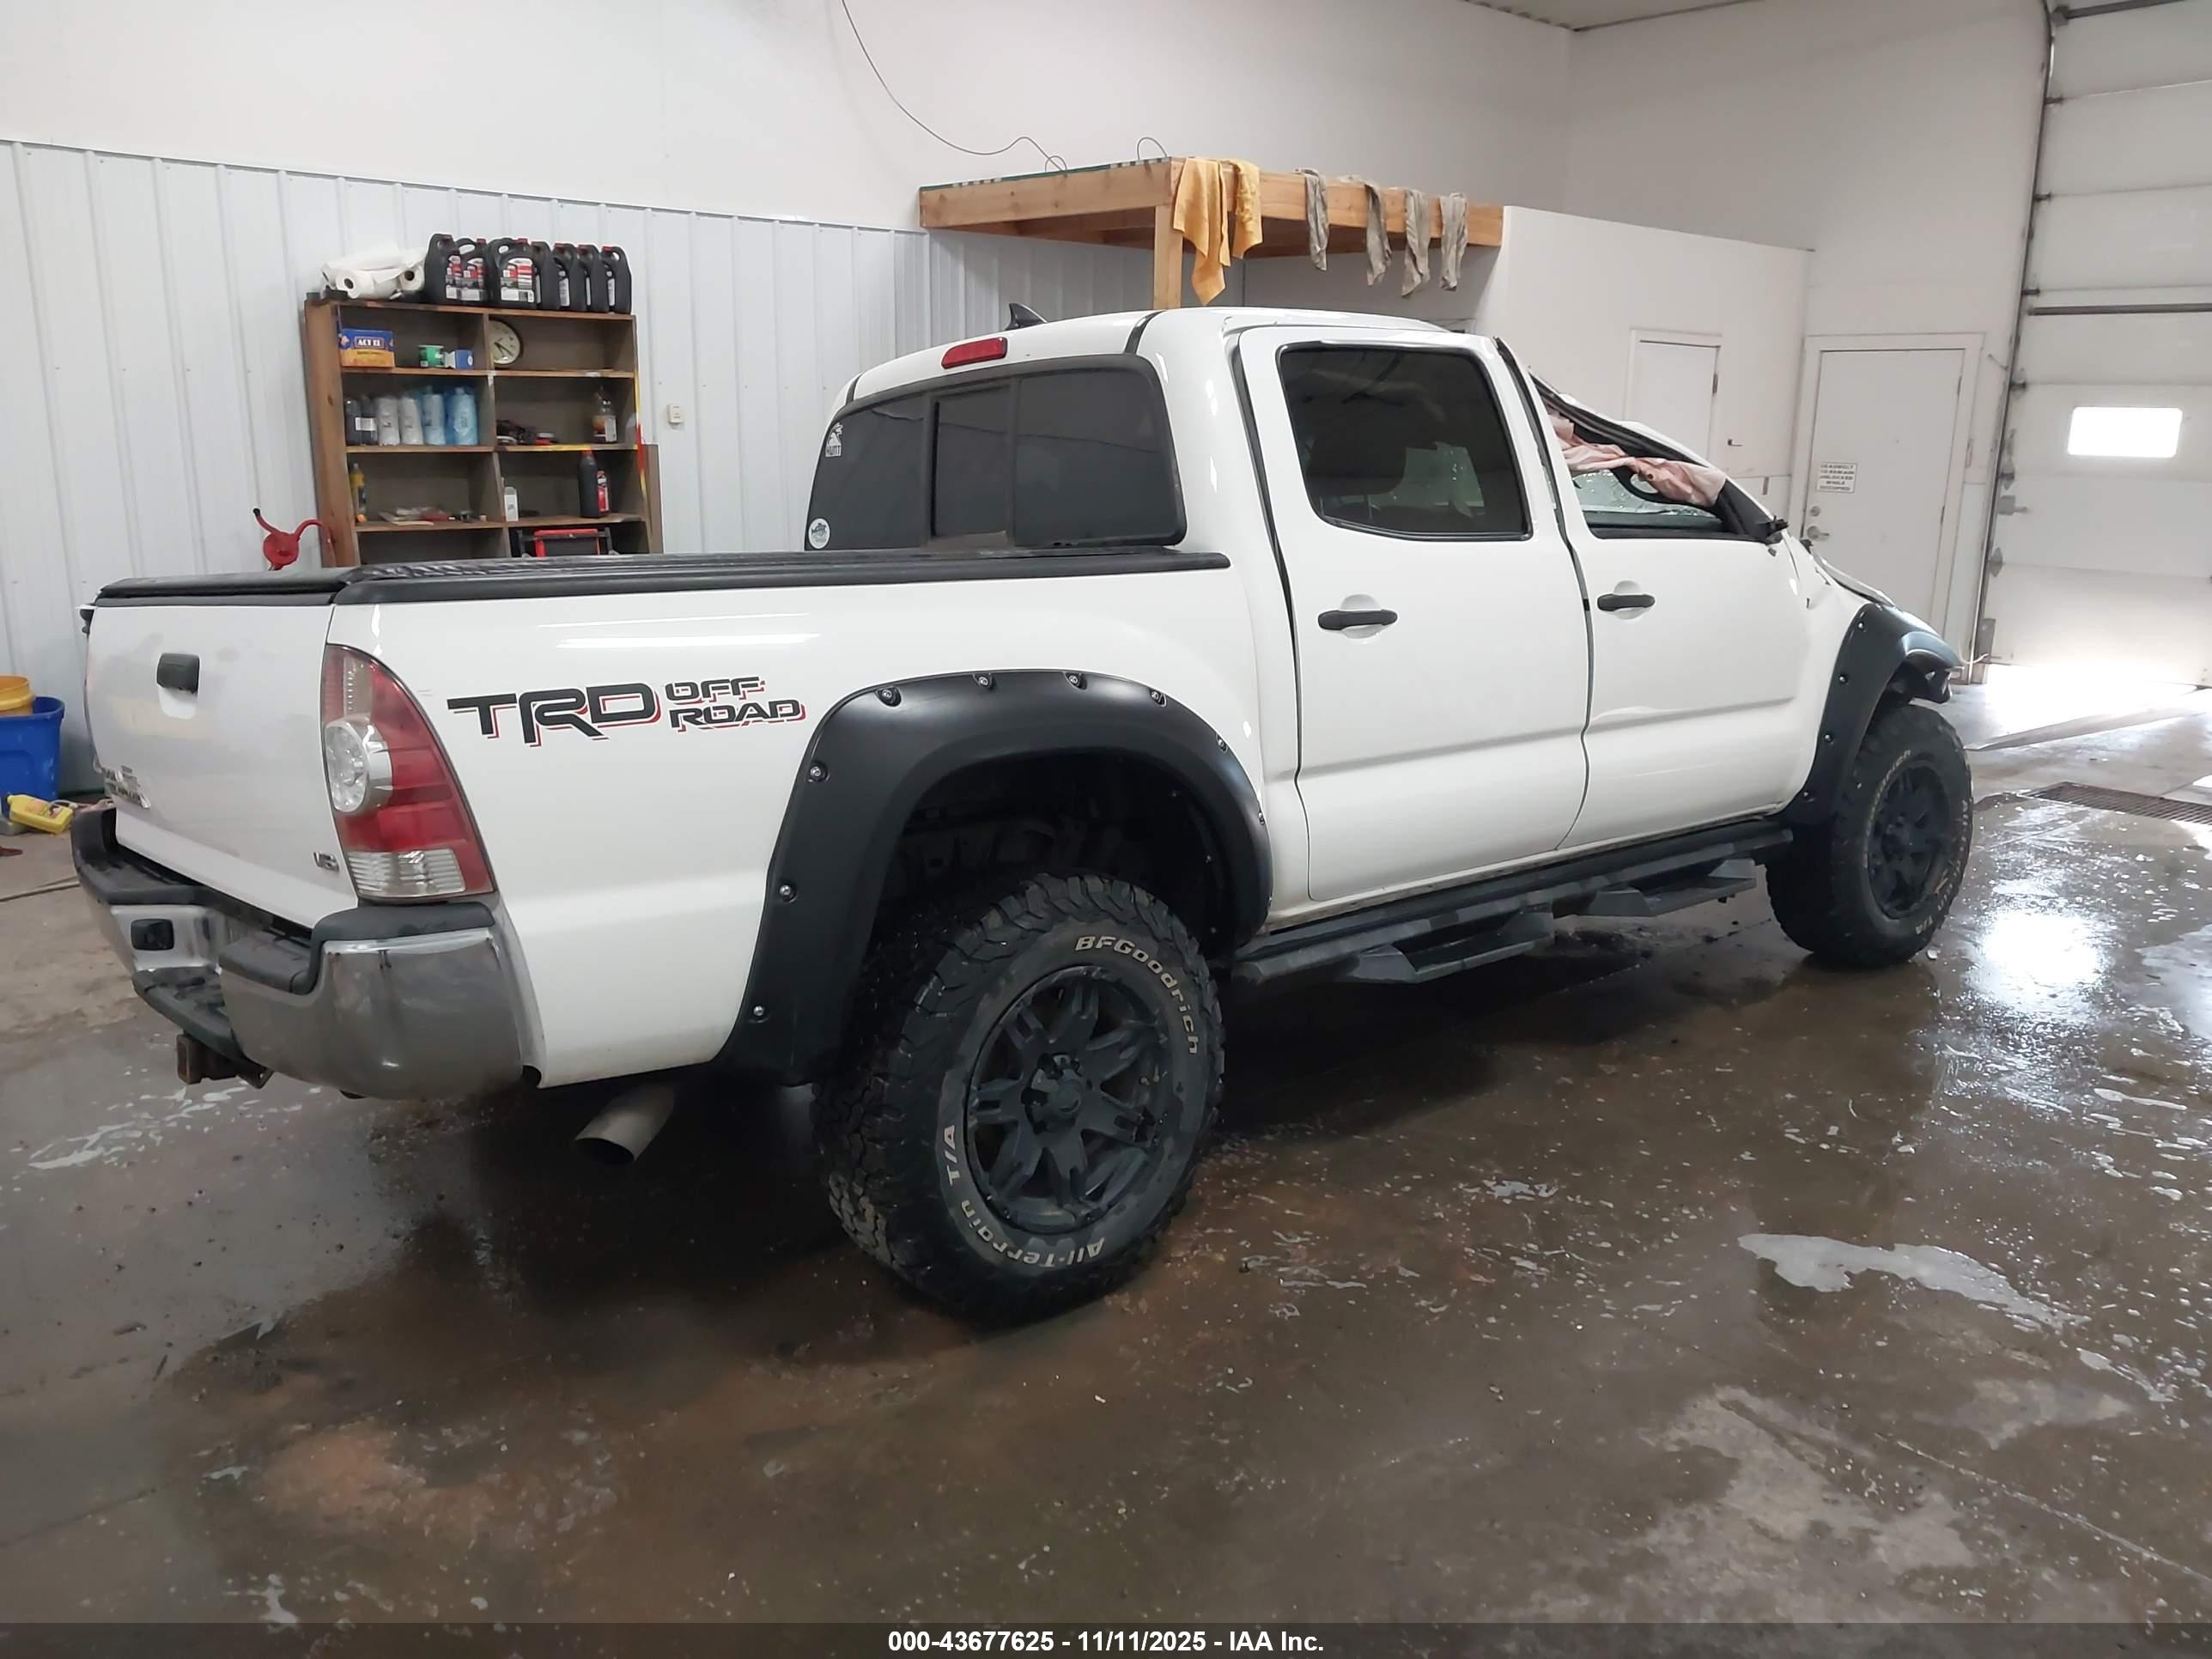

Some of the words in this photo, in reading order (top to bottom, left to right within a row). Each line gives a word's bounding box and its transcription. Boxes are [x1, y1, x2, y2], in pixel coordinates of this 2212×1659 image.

[446, 682, 661, 747] TRD
[665, 676, 765, 705] OFF
[669, 699, 806, 732] ROAD
[1075, 934, 1199, 1054] BFGoodrich
[944, 1124, 962, 1187] T/A
[961, 1200, 1105, 1267] All-Terrain
